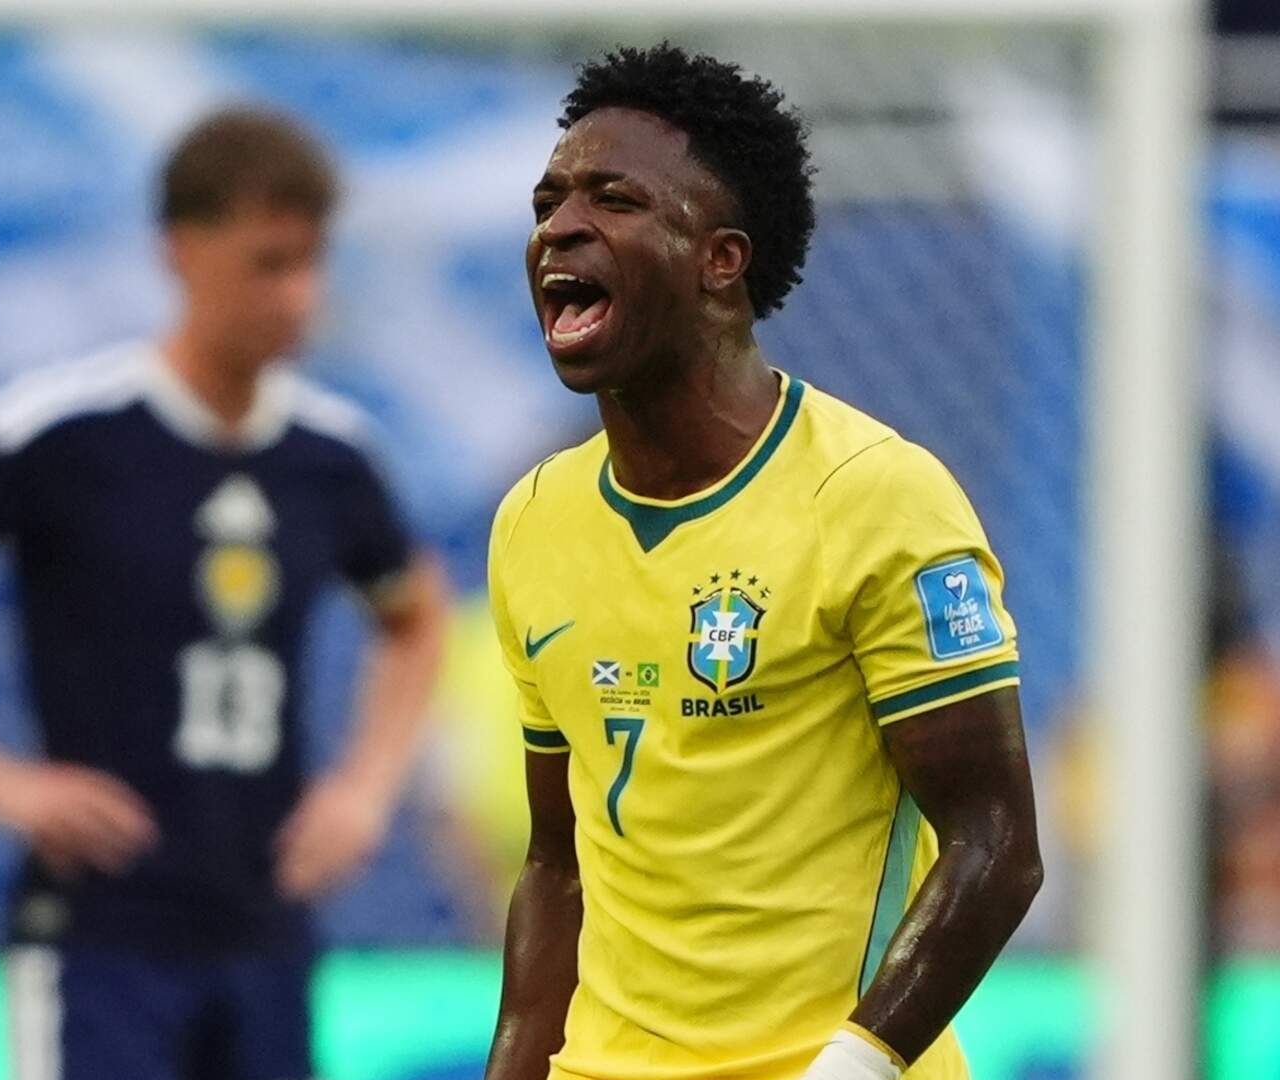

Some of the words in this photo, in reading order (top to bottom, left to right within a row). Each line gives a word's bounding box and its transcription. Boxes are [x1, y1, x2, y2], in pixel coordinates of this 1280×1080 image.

[708, 629, 737, 642] CBF
[949, 613, 985, 637] PEACE
[681, 694, 765, 717] BRASIL
[604, 717, 645, 837] 7
